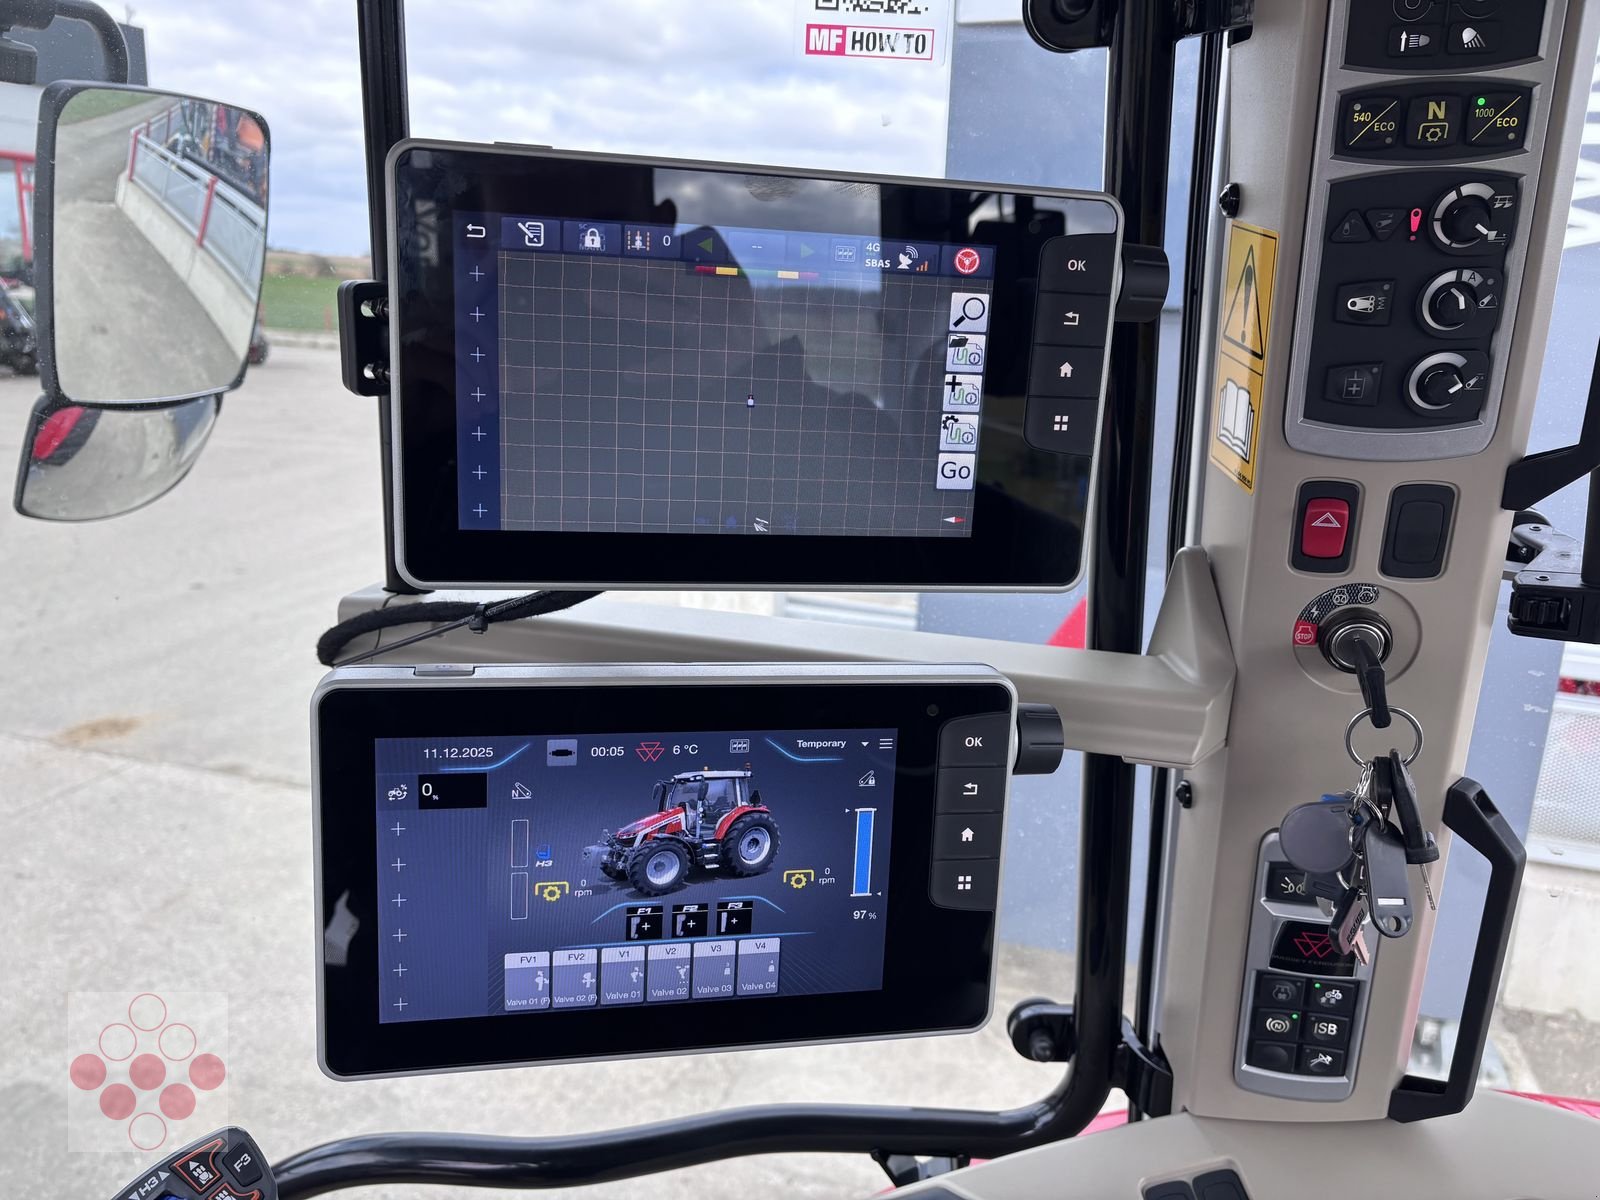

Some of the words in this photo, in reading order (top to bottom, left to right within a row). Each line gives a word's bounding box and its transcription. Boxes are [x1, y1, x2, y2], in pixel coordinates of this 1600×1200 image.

[809, 28, 843, 51] MF
[851, 31, 900, 53] HOW
[903, 34, 926, 54] TO
[1427, 101, 1446, 120] N
[1475, 107, 1495, 118] 1000
[1353, 112, 1372, 122] 540
[1496, 117, 1518, 128] ECO
[1374, 121, 1395, 131] ECO
[662, 235, 672, 247] 0
[866, 242, 880, 253] 4G
[865, 258, 891, 269] SBAS
[1067, 259, 1087, 272] OK
[1468, 271, 1477, 282] A
[940, 461, 971, 480] Go
[796, 739, 847, 750] Temporary
[965, 737, 983, 748] OK
[423, 747, 494, 759] 11.12.2025
[591, 746, 625, 757] 00:05
[673, 745, 681, 755] 6
[684, 744, 699, 755] °C
[421, 783, 433, 797] 0
[824, 867, 831, 876] 0
[580, 879, 587, 887] 0
[818, 877, 836, 885] rpm
[574, 890, 592, 898] rpm
[853, 910, 867, 920] 97
[868, 912, 877, 920] %
[710, 945, 722, 953] V3
[755, 942, 766, 950] V4
[520, 956, 537, 964] FV1
[568, 953, 585, 961] FV2
[697, 985, 719, 994] Valve
[721, 984, 733, 993] 03
[741, 982, 763, 991] Valve
[765, 981, 777, 990] 04
[605, 991, 628, 1000] Valve
[630, 990, 641, 998] 01
[651, 988, 674, 997] Valve
[676, 988, 687, 996] 02
[506, 998, 527, 1006] Valve
[528, 997, 538, 1005] 01
[554, 995, 575, 1003] Valve
[576, 994, 586, 1002] 02
[1314, 1023, 1338, 1035] ISB
[233, 1153, 252, 1173] F3
[138, 1178, 159, 1197] H3
